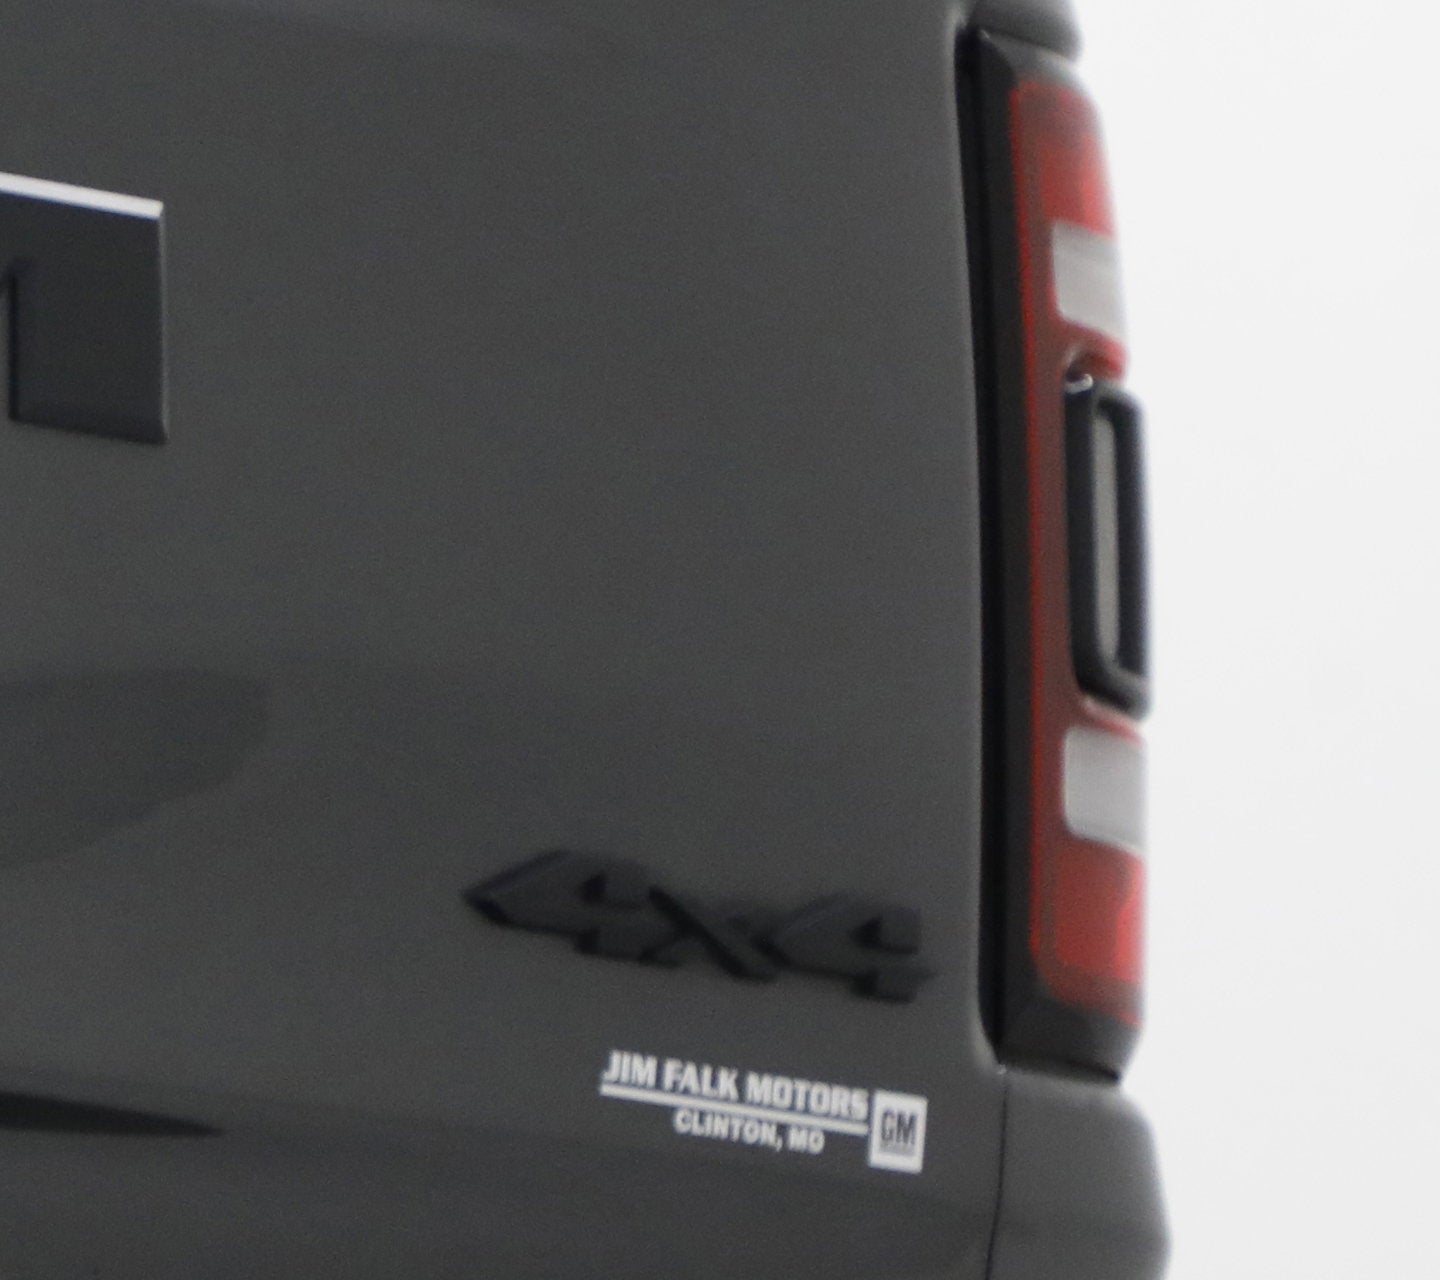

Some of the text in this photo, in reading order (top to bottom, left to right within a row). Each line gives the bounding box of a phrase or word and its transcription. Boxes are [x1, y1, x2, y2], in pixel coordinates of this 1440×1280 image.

[602, 1049, 870, 1121] JIM FALK MOTORS
[673, 1108, 826, 1155] CLINTON, MO
[880, 1108, 918, 1148] GM
